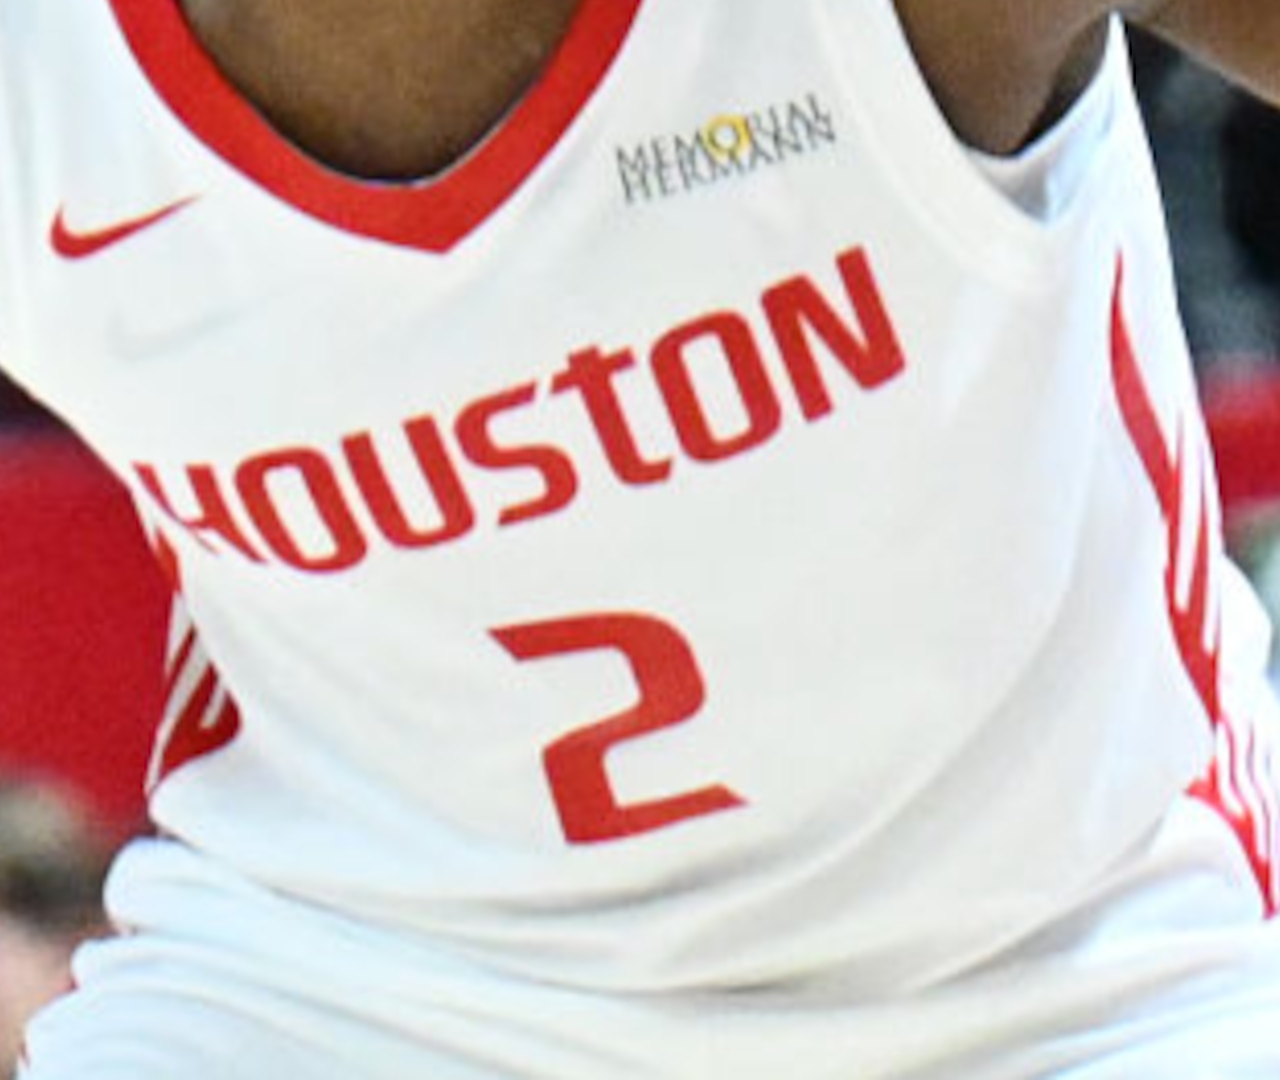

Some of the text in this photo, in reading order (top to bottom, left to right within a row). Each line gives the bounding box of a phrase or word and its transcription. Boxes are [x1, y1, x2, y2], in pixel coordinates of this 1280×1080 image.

[615, 92, 832, 174] MEMORIAL
[132, 245, 907, 574] HOUSTON
[487, 610, 748, 846] 2
